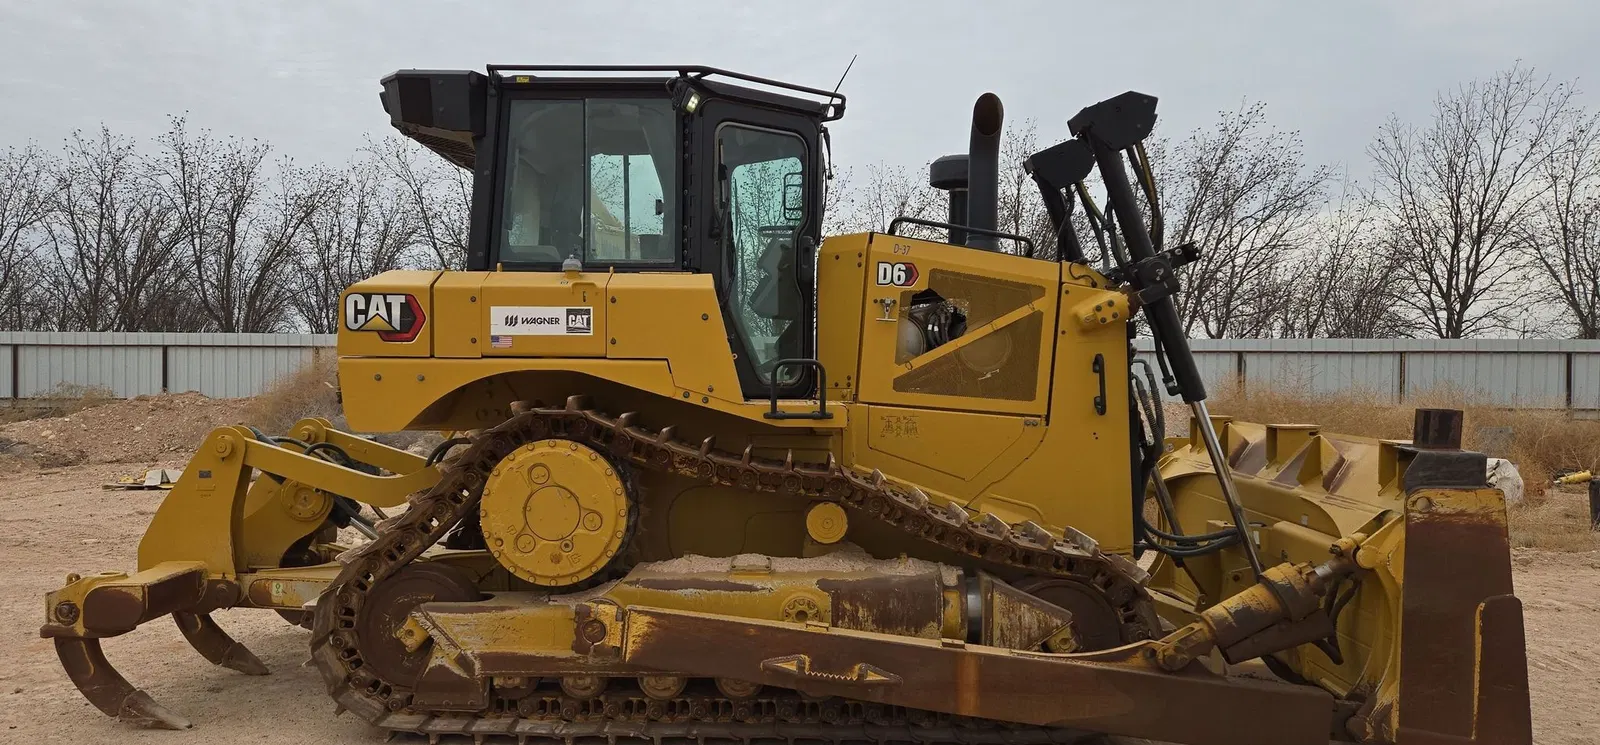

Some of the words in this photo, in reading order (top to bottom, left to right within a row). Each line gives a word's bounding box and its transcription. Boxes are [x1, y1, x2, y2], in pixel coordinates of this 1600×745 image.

[893, 243, 911, 255] D-37
[878, 262, 907, 286] D6
[345, 293, 406, 331] CAT
[521, 317, 560, 325] WAGNER
[568, 314, 589, 329] CAT
